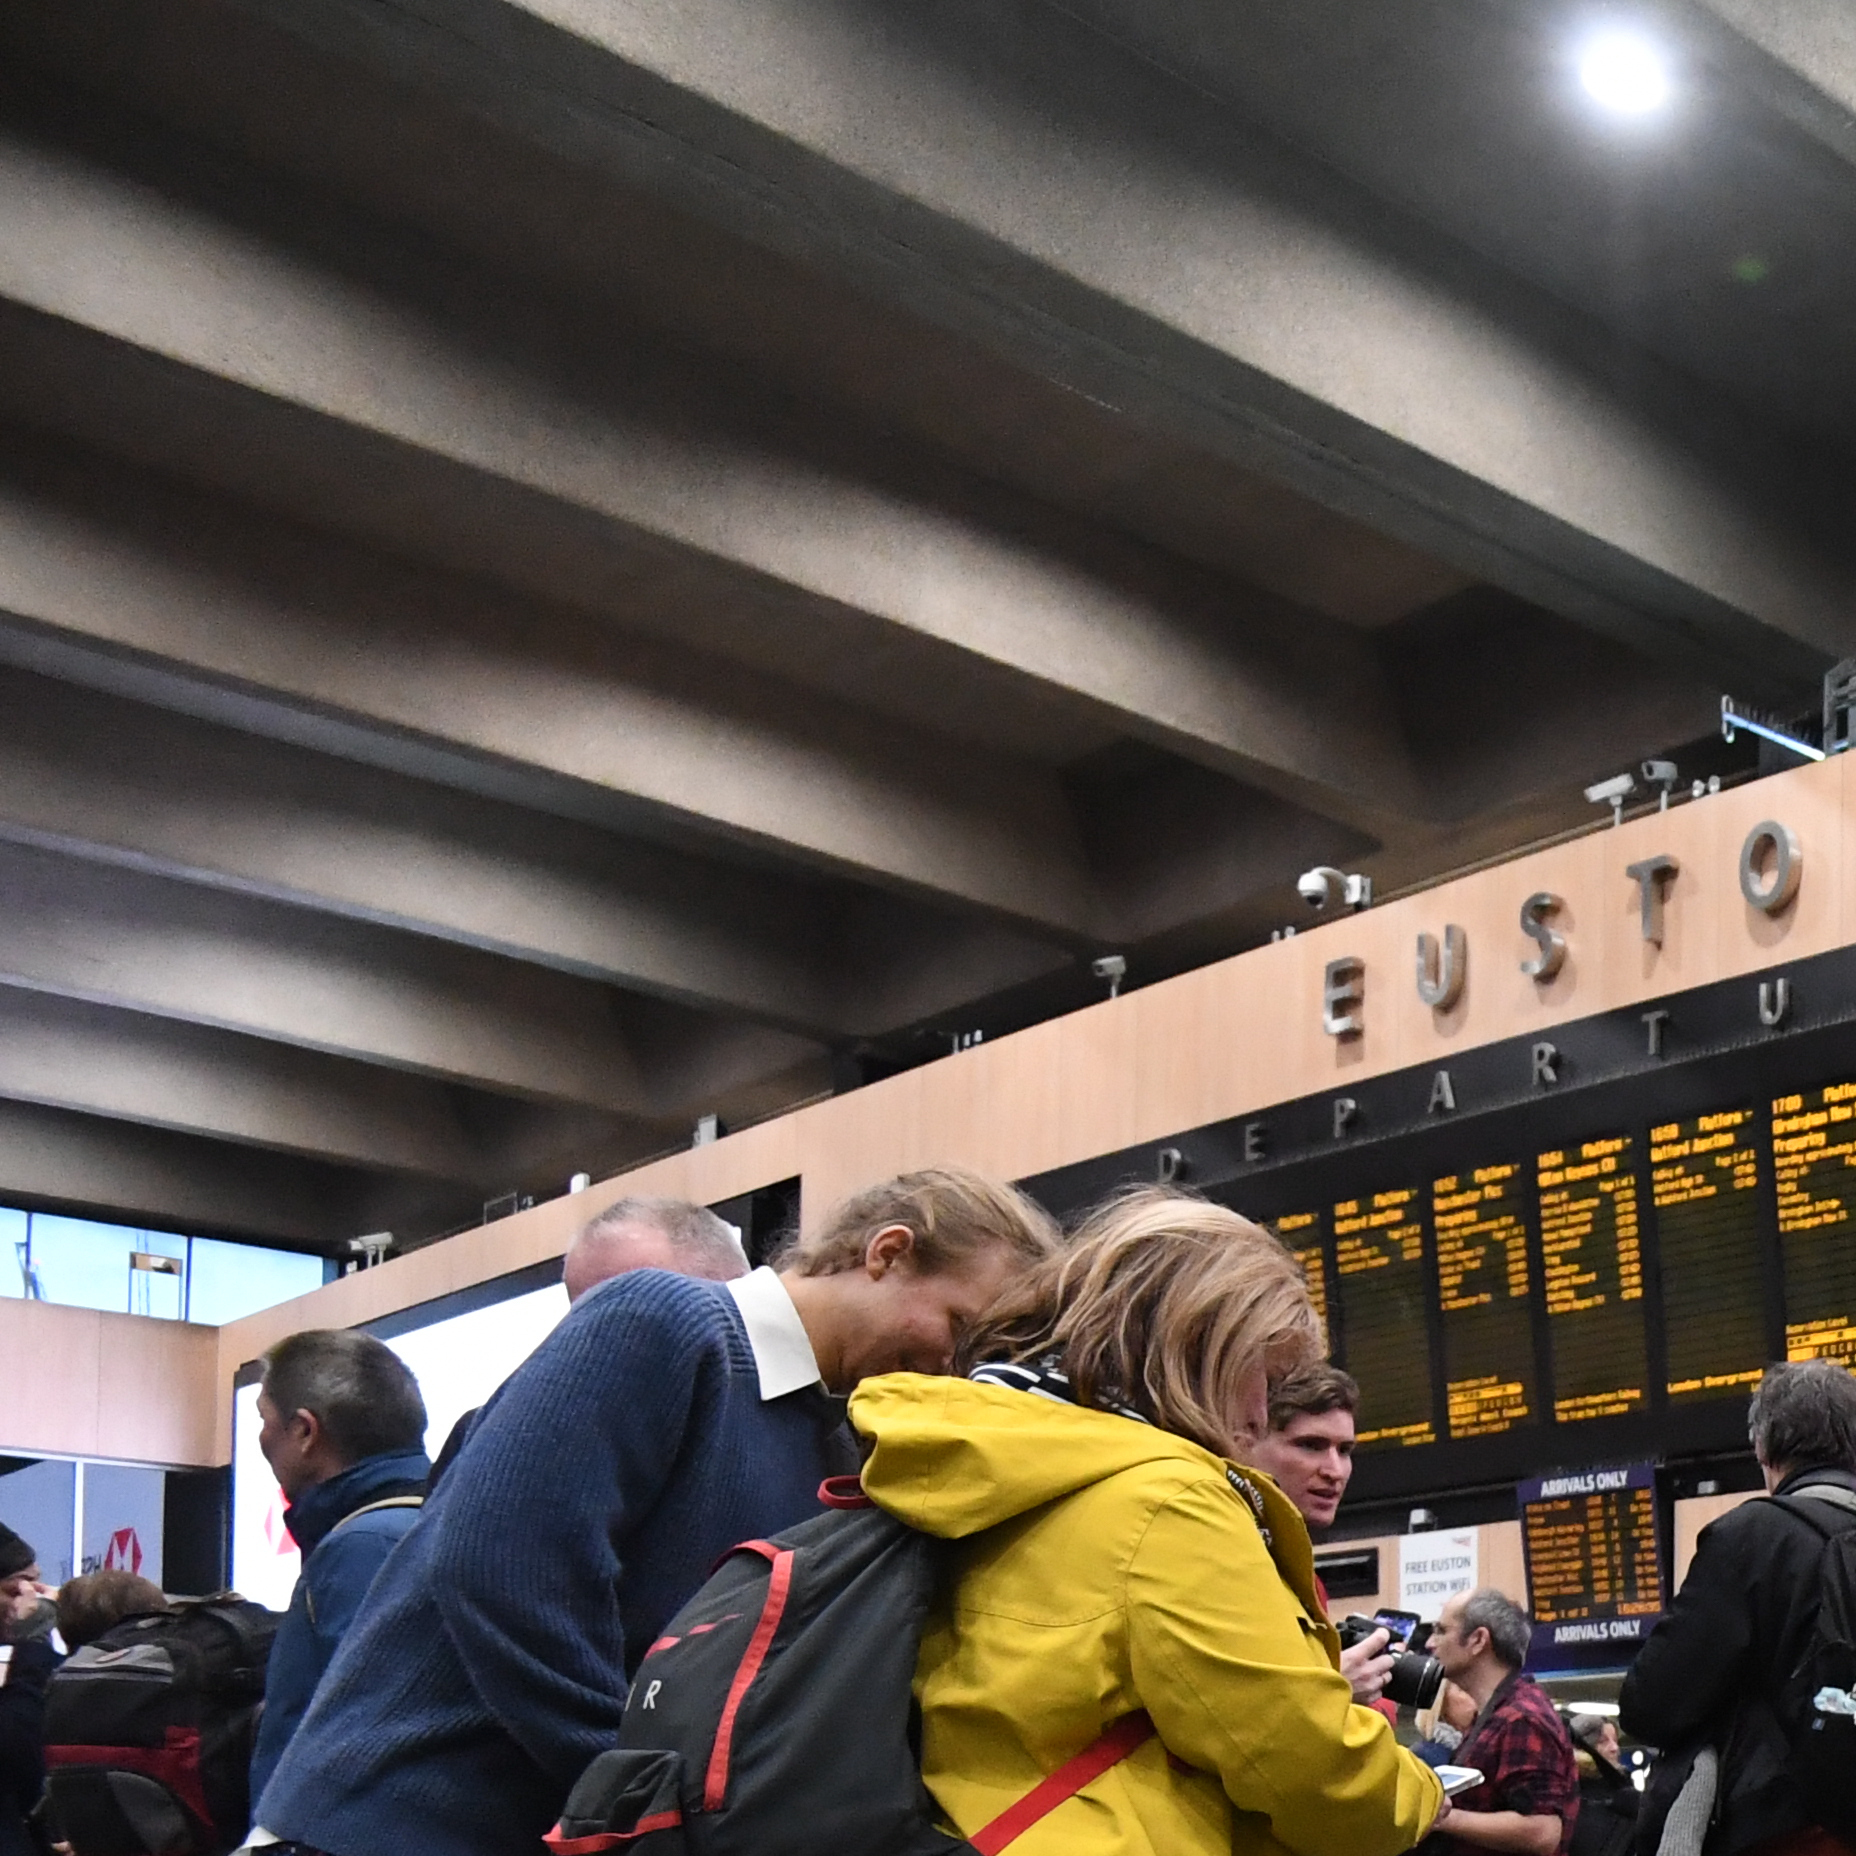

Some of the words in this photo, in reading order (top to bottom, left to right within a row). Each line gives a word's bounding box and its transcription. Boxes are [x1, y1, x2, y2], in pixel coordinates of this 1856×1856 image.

[1541, 1474, 1595, 1497] ARRIVALS
[1597, 1470, 1629, 1488] ONLY
[1405, 1561, 1428, 1574] FREE
[1431, 1556, 1471, 1570] EUSTON
[1406, 1581, 1446, 1596] STATION
[1554, 1622, 1608, 1643] ARRIVALS
[1610, 1620, 1641, 1637] ONLY
